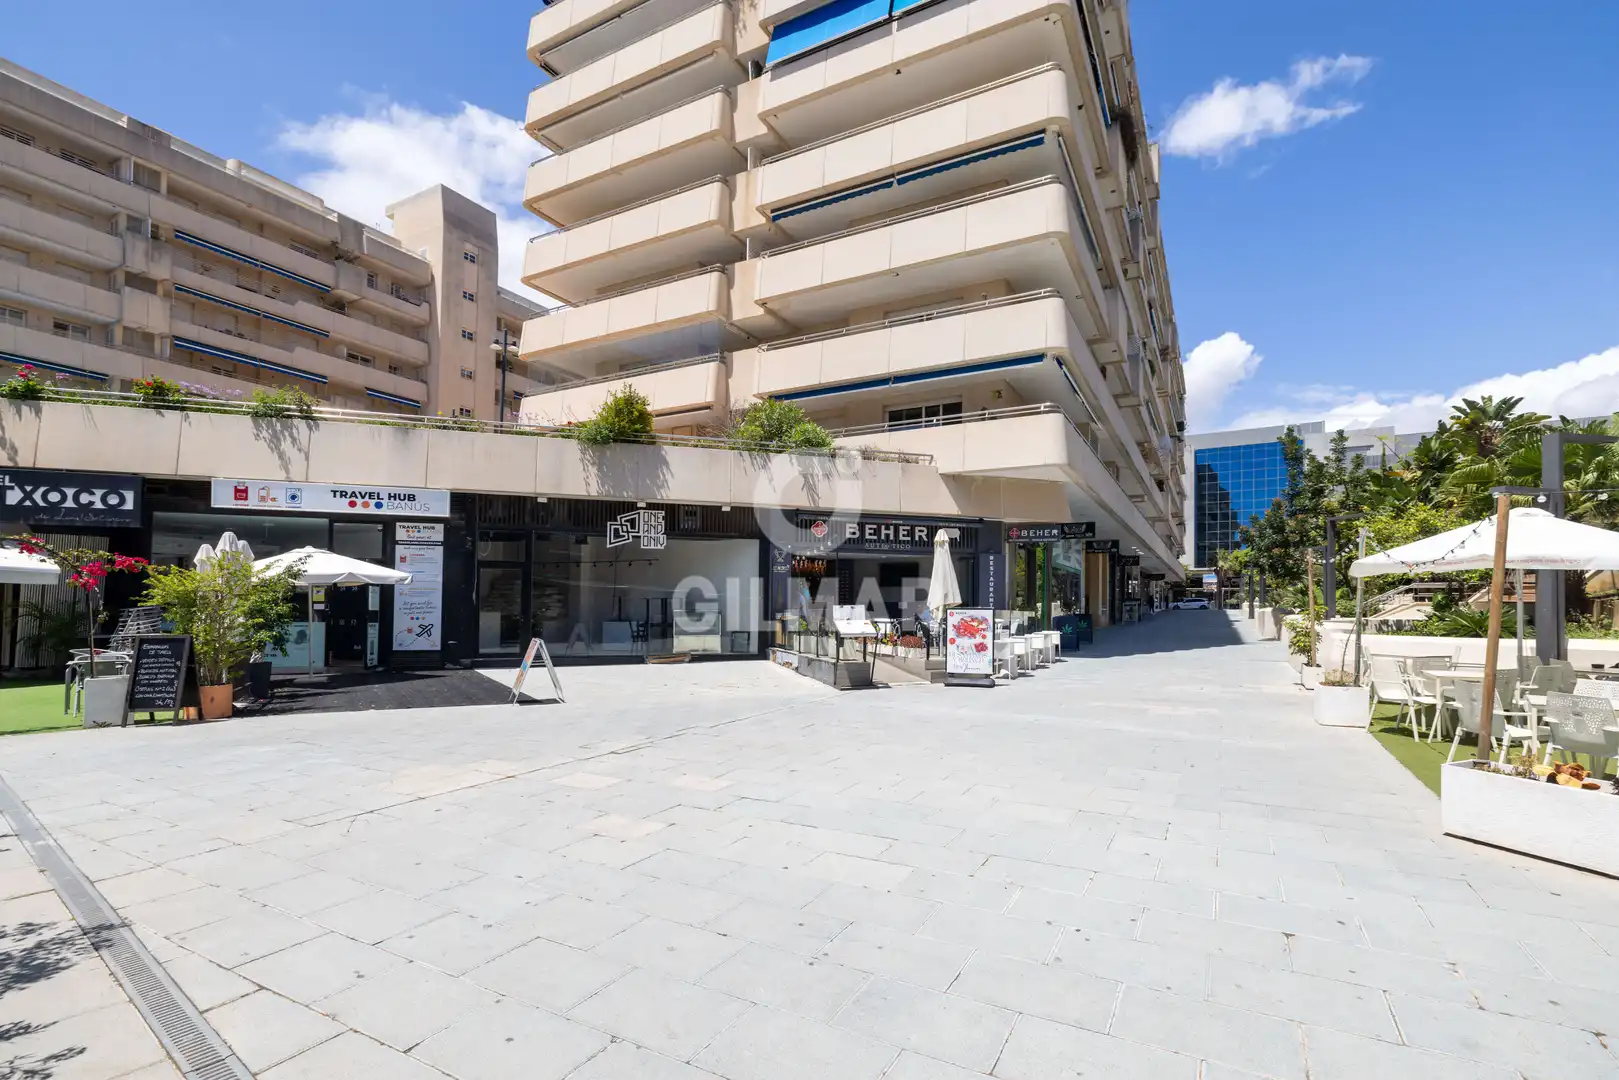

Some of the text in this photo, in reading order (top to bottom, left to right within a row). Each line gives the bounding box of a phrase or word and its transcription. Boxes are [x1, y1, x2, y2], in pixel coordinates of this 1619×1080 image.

[331, 490, 416, 502] TRAVEL HUB
[386, 501, 430, 512] BANÚS
[642, 511, 664, 523] ONE
[642, 523, 664, 535] AND
[845, 523, 928, 541] BEHER
[1021, 529, 1058, 537] BEHER
